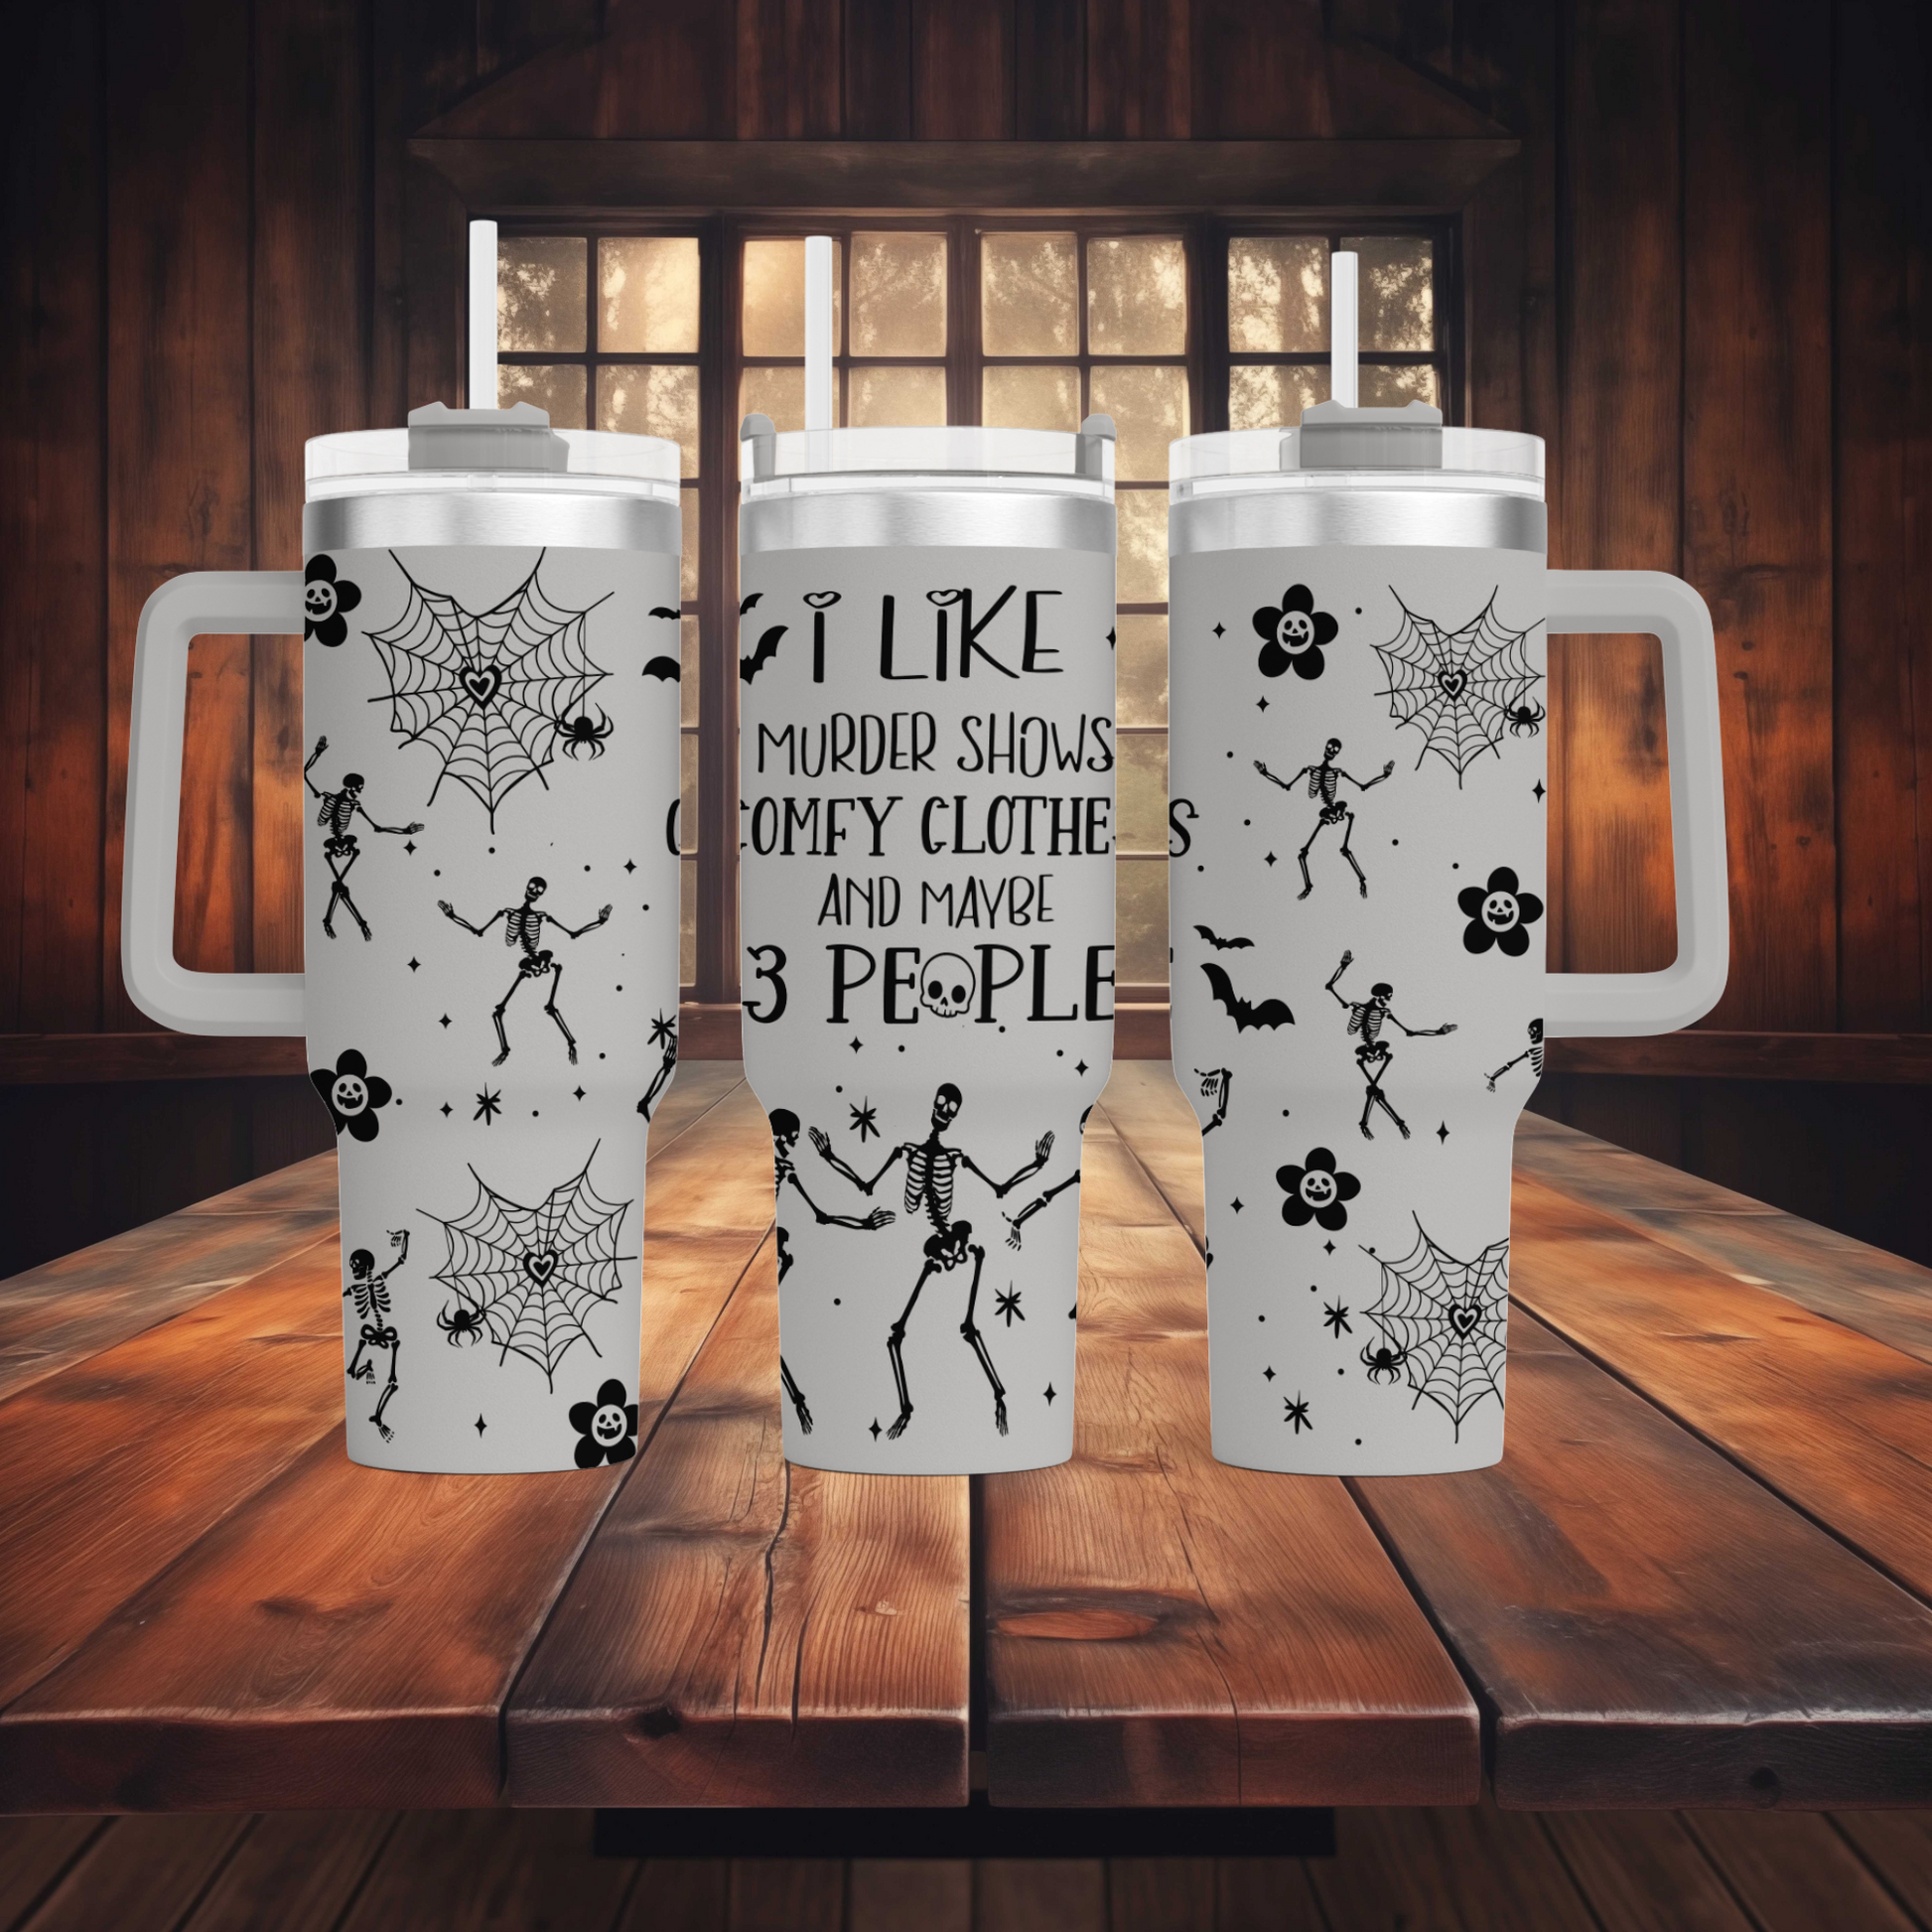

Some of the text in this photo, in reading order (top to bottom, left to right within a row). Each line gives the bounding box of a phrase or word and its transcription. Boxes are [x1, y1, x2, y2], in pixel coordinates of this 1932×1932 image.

[759, 712, 1115, 778] MURDER SHOWS
[921, 795, 1116, 857] CLOTHE
[817, 873, 1054, 929] AND MAYBE
[742, 944, 787, 1024] 3
